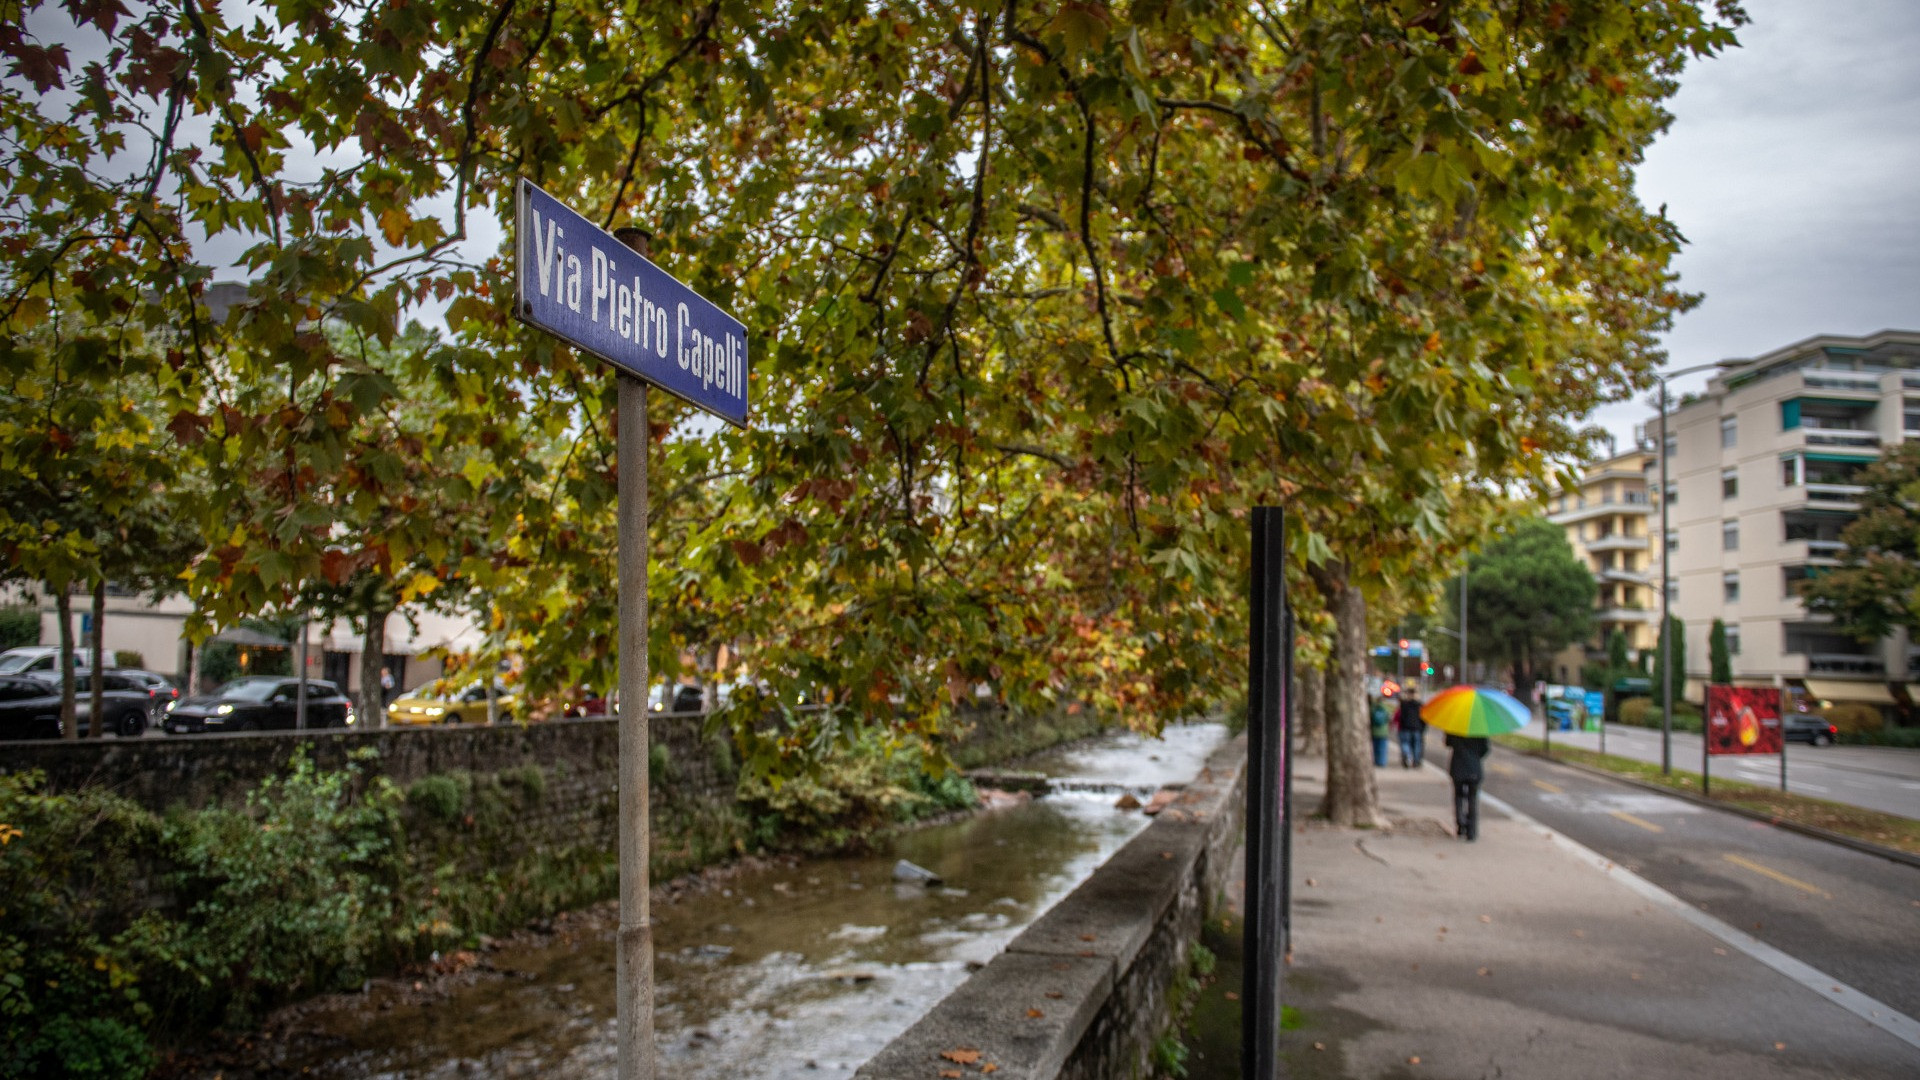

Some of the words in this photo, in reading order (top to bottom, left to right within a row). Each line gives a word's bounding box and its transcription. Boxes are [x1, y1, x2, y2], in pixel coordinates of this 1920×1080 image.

[533, 208, 582, 314] Via
[591, 245, 668, 359] Pietro
[677, 302, 742, 400] Capelli
